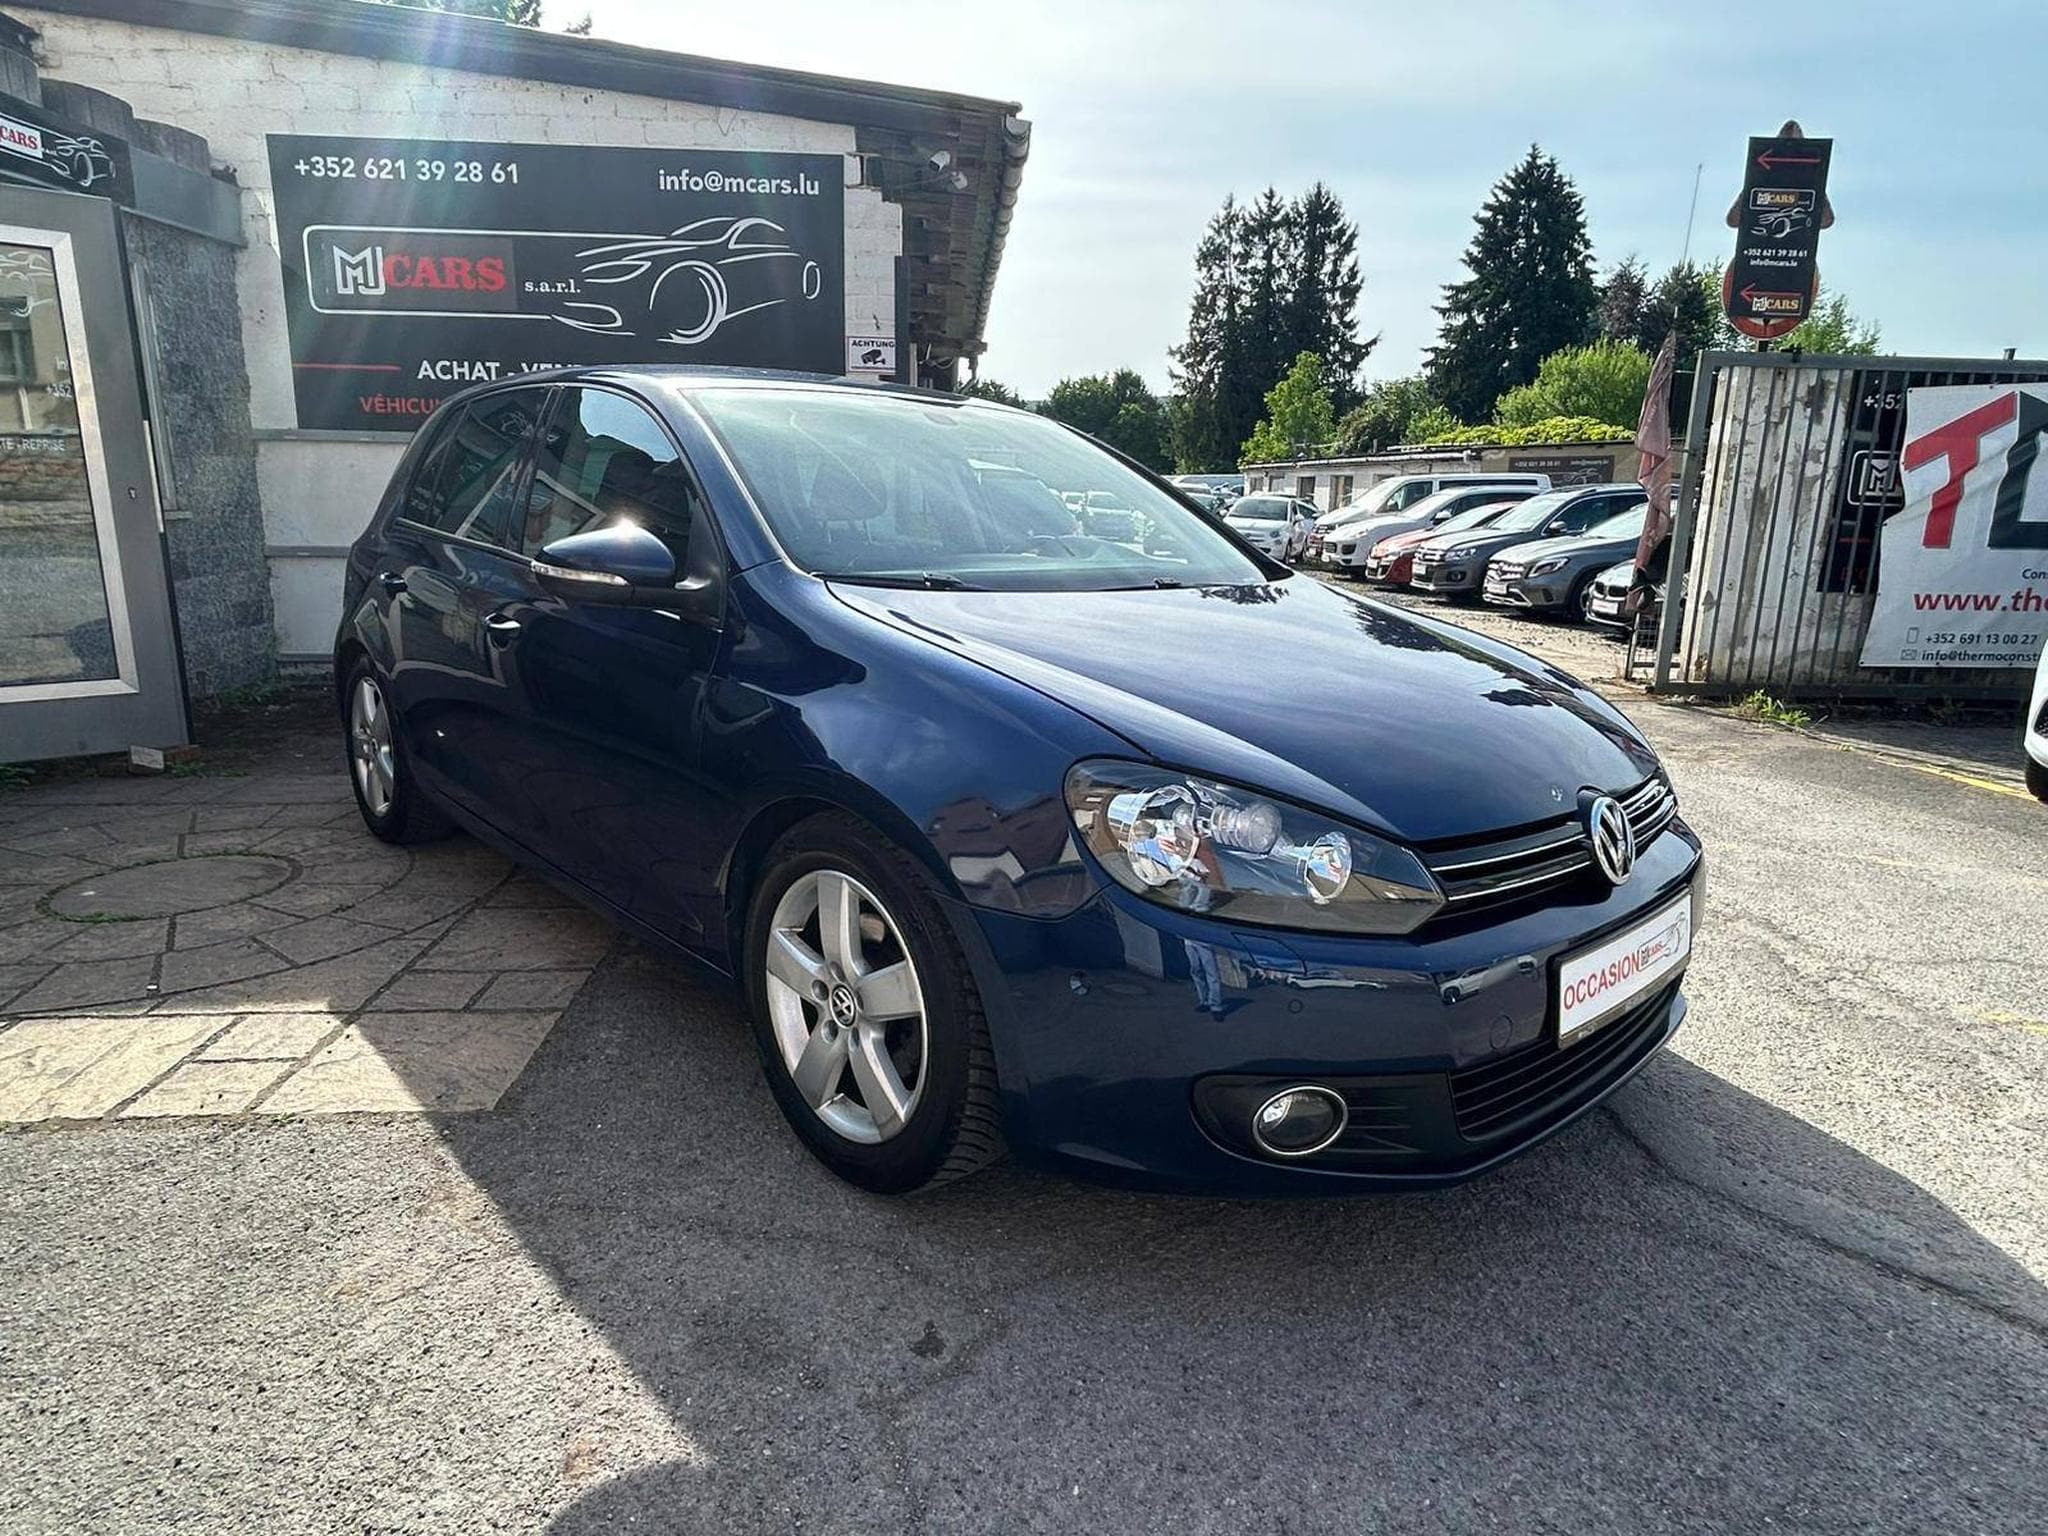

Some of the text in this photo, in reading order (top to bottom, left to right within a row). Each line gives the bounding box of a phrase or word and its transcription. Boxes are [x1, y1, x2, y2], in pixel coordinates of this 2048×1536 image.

[294, 155, 519, 184] +352 621 39 28 61
[658, 169, 820, 195] info@mcars.lu
[524, 279, 582, 294] s.a.r.l.
[851, 340, 896, 348] ACHTUNG
[416, 360, 500, 381] ACHAT
[1925, 633, 2038, 645] +352 691 13 00 27
[1563, 949, 1641, 1010] OCCASION
